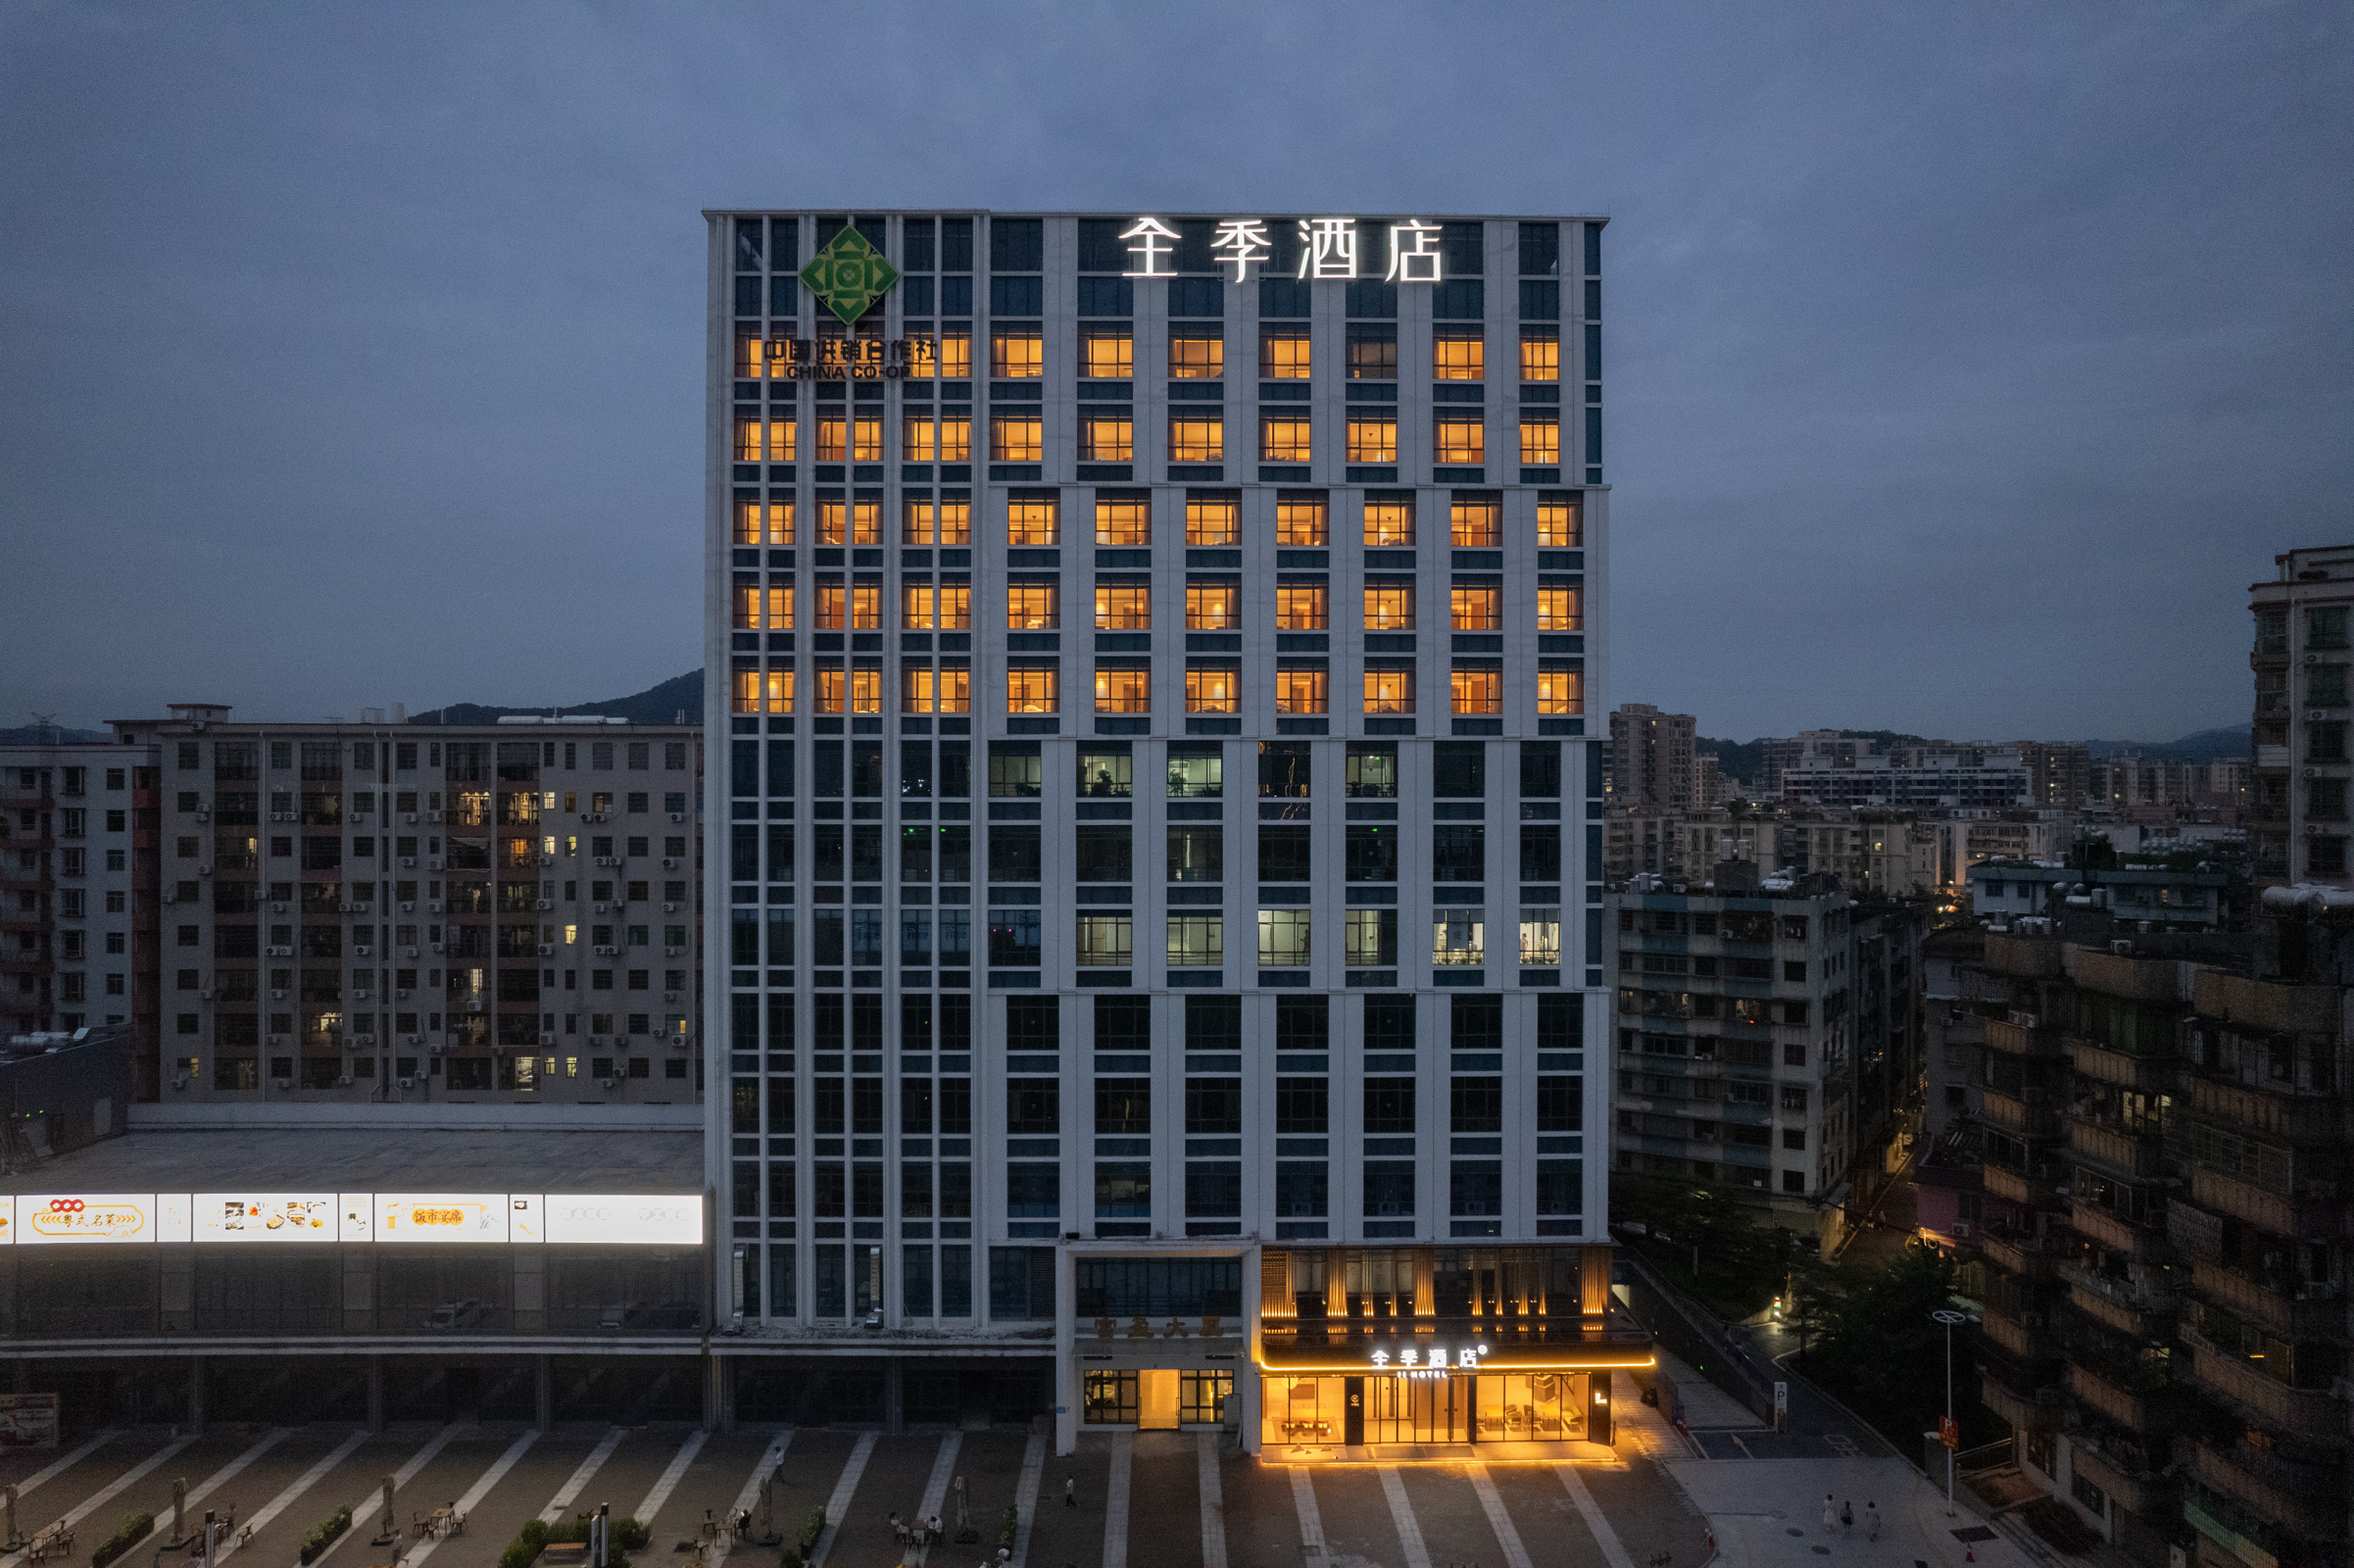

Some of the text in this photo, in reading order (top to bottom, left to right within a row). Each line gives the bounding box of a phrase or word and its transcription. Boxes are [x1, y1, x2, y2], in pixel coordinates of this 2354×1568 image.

[1118, 218, 1444, 283] 全季酒店
[763, 339, 937, 361] 中国供销合作社
[786, 366, 911, 379] CHINA CO-OP
[62, 1213, 116, 1228] 粤式名菜
[414, 1209, 462, 1224] 饭市宴席
[1370, 1348, 1477, 1368] 全季酒店
[1777, 1391, 1785, 1401] P
[1944, 1418, 1953, 1430] P
